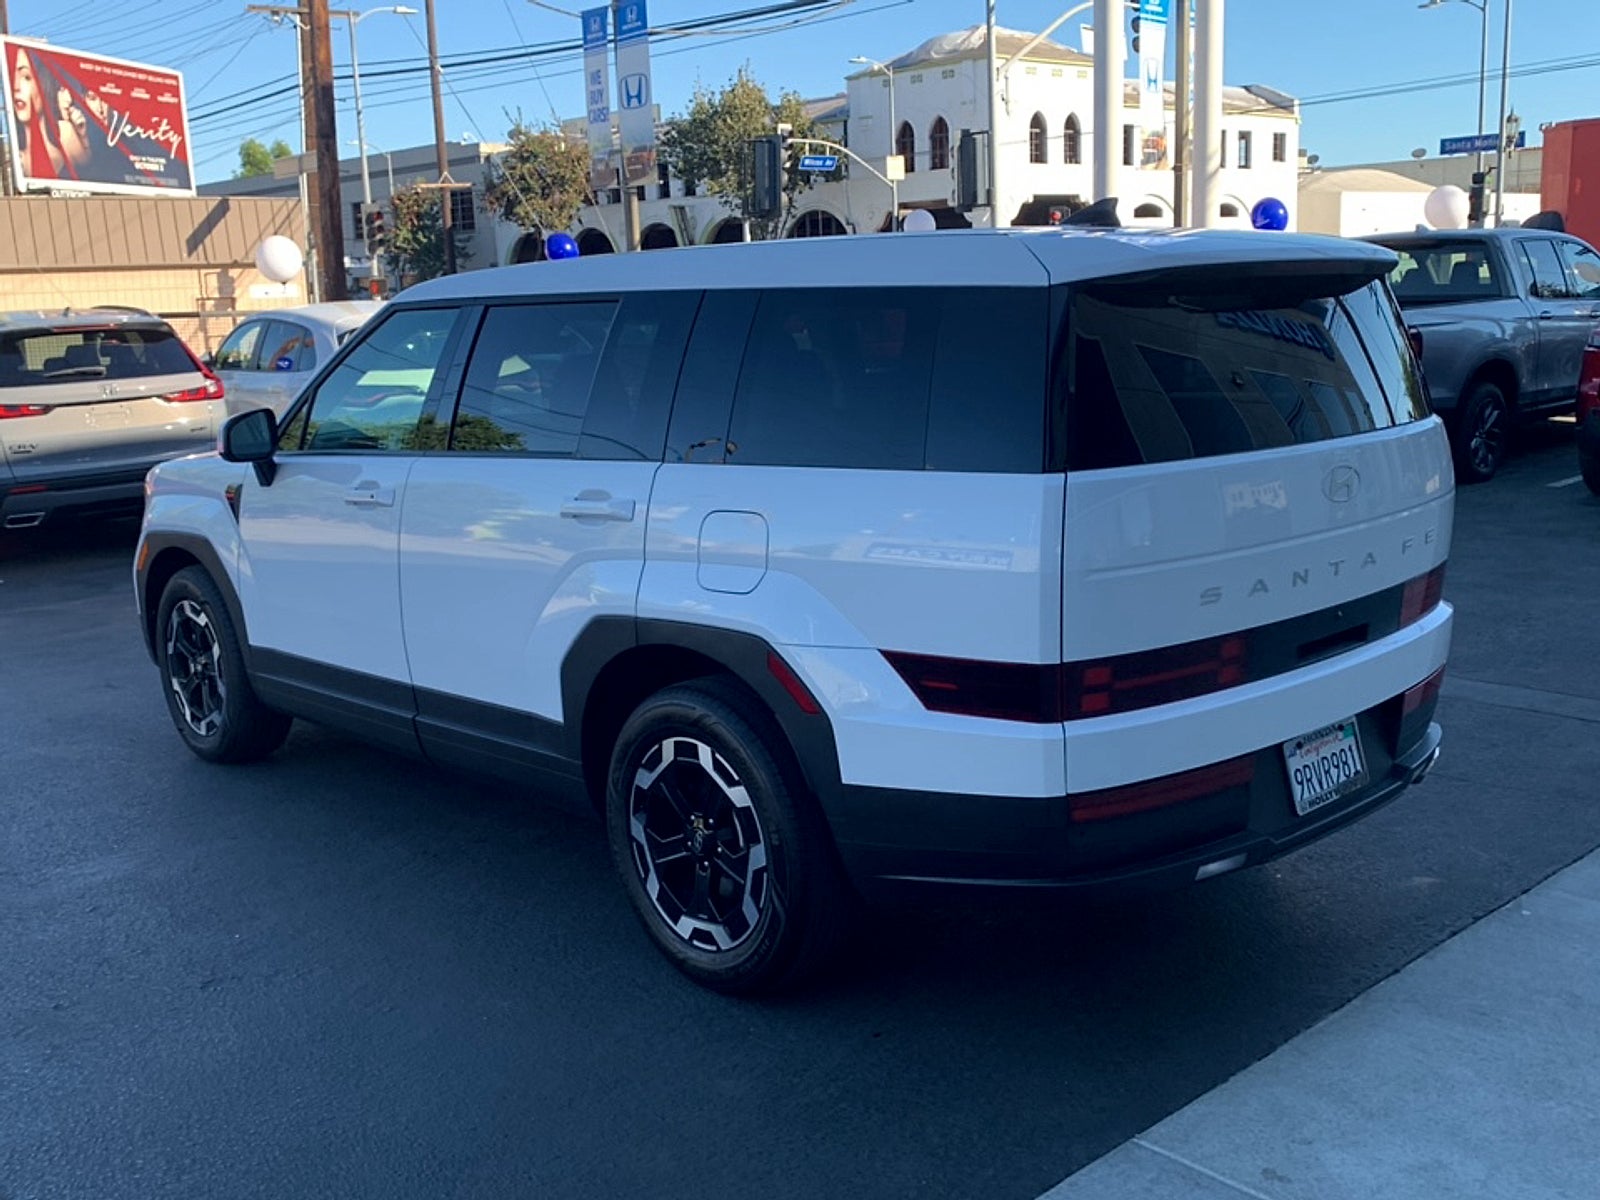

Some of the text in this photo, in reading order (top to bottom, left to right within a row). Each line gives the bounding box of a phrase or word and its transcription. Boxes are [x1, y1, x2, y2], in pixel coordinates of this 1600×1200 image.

[590, 88, 604, 106] BUY
[107, 110, 182, 159] Verity
[1444, 140, 1472, 152] Santa
[1199, 527, 1436, 606] SANTA FE
[1293, 743, 1361, 801] 9RVR981
